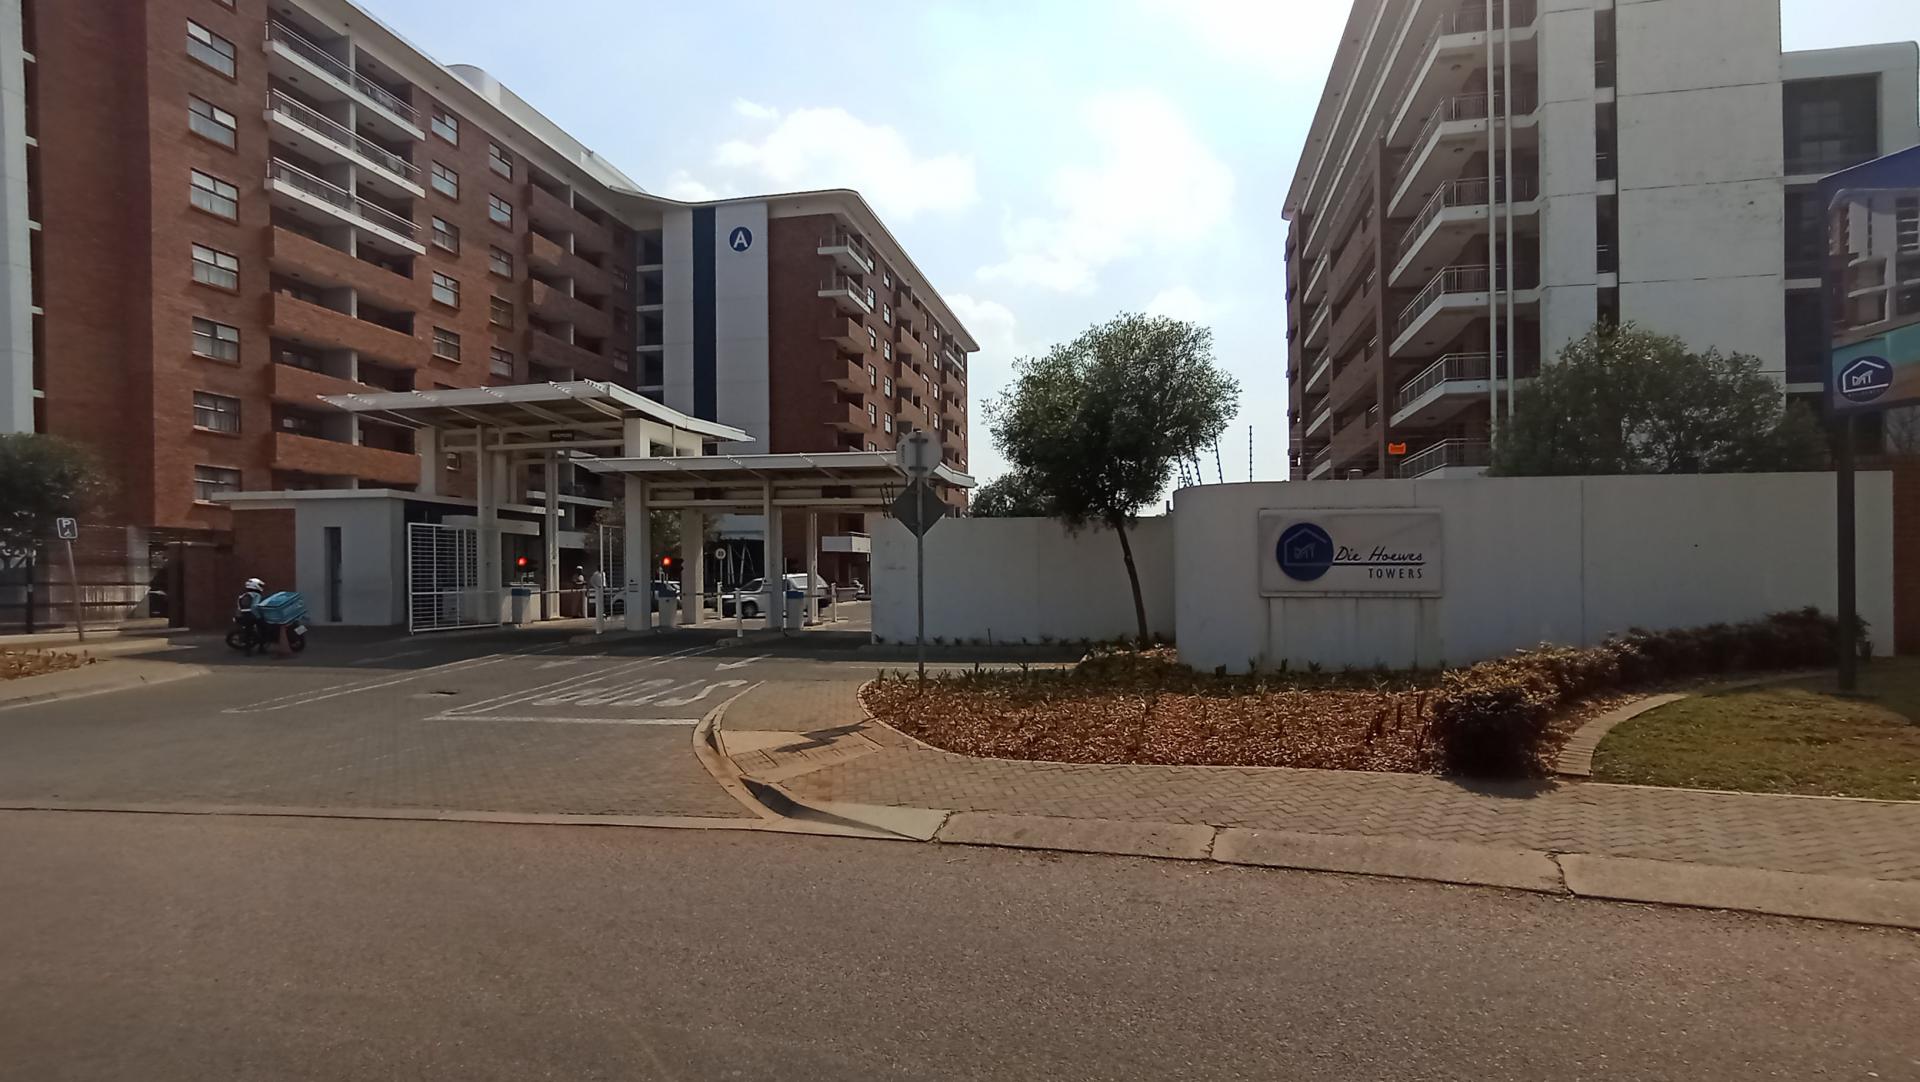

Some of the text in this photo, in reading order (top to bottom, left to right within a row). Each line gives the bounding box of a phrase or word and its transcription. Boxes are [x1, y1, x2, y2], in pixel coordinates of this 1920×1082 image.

[733, 230, 749, 248] A
[62, 519, 72, 529] P
[1334, 545, 1422, 561] Die Hoewes
[1368, 567, 1422, 579] TOWERS
